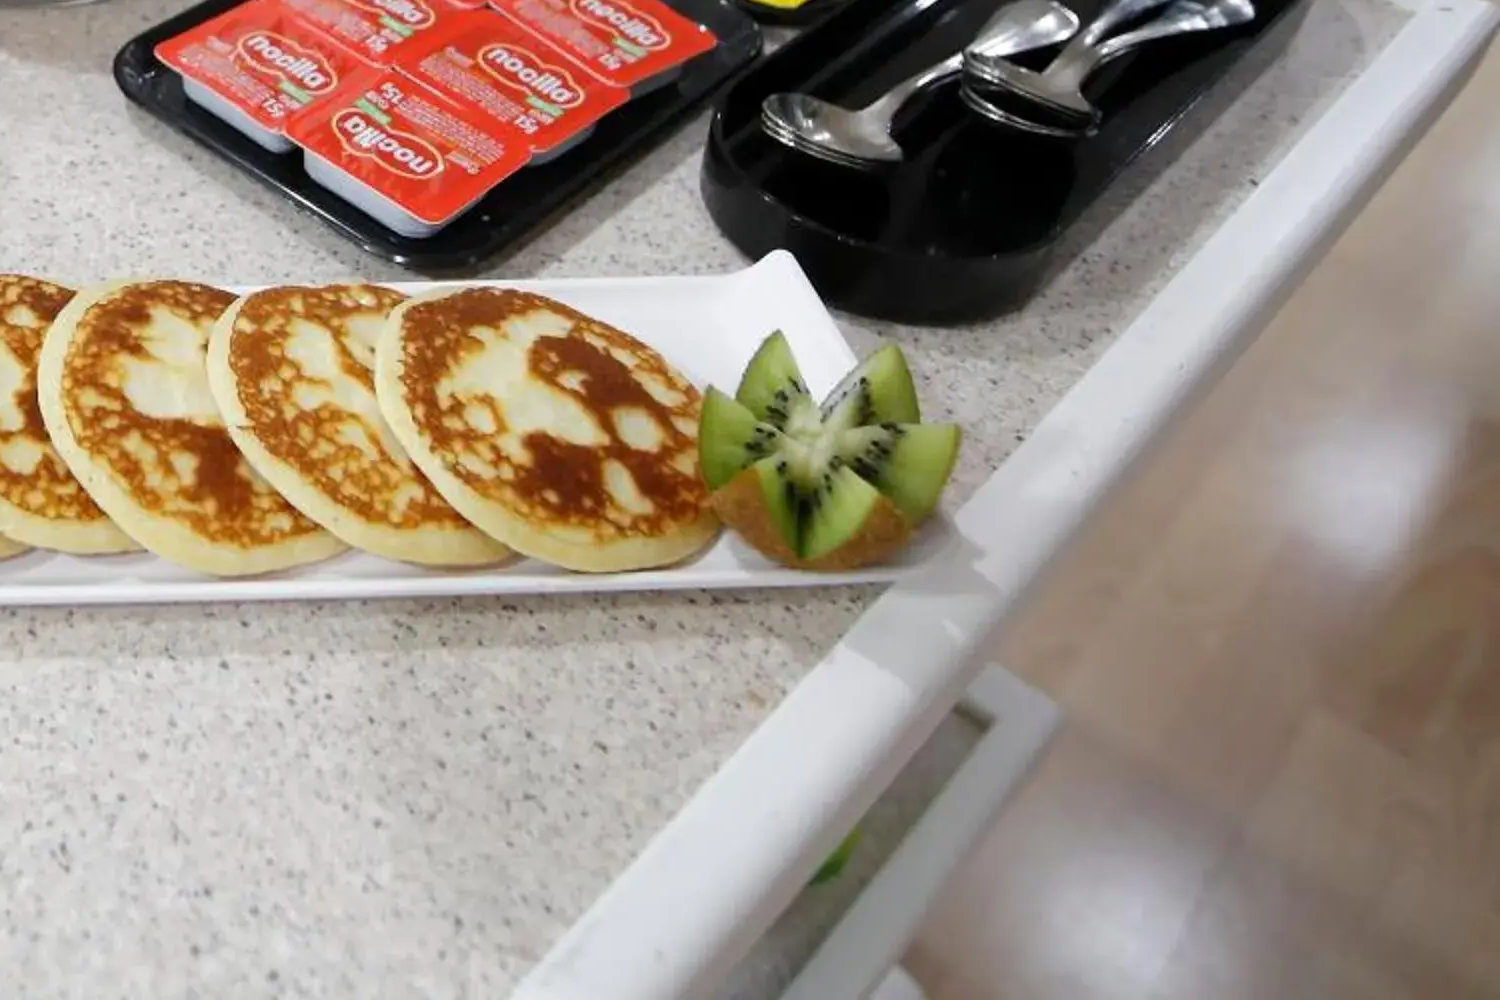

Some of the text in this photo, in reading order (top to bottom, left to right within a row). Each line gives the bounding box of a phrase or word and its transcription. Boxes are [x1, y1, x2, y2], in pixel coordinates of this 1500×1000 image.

[247, 35, 328, 89] nocilla
[486, 45, 573, 103] nocilla
[342, 114, 435, 174] nocilla
